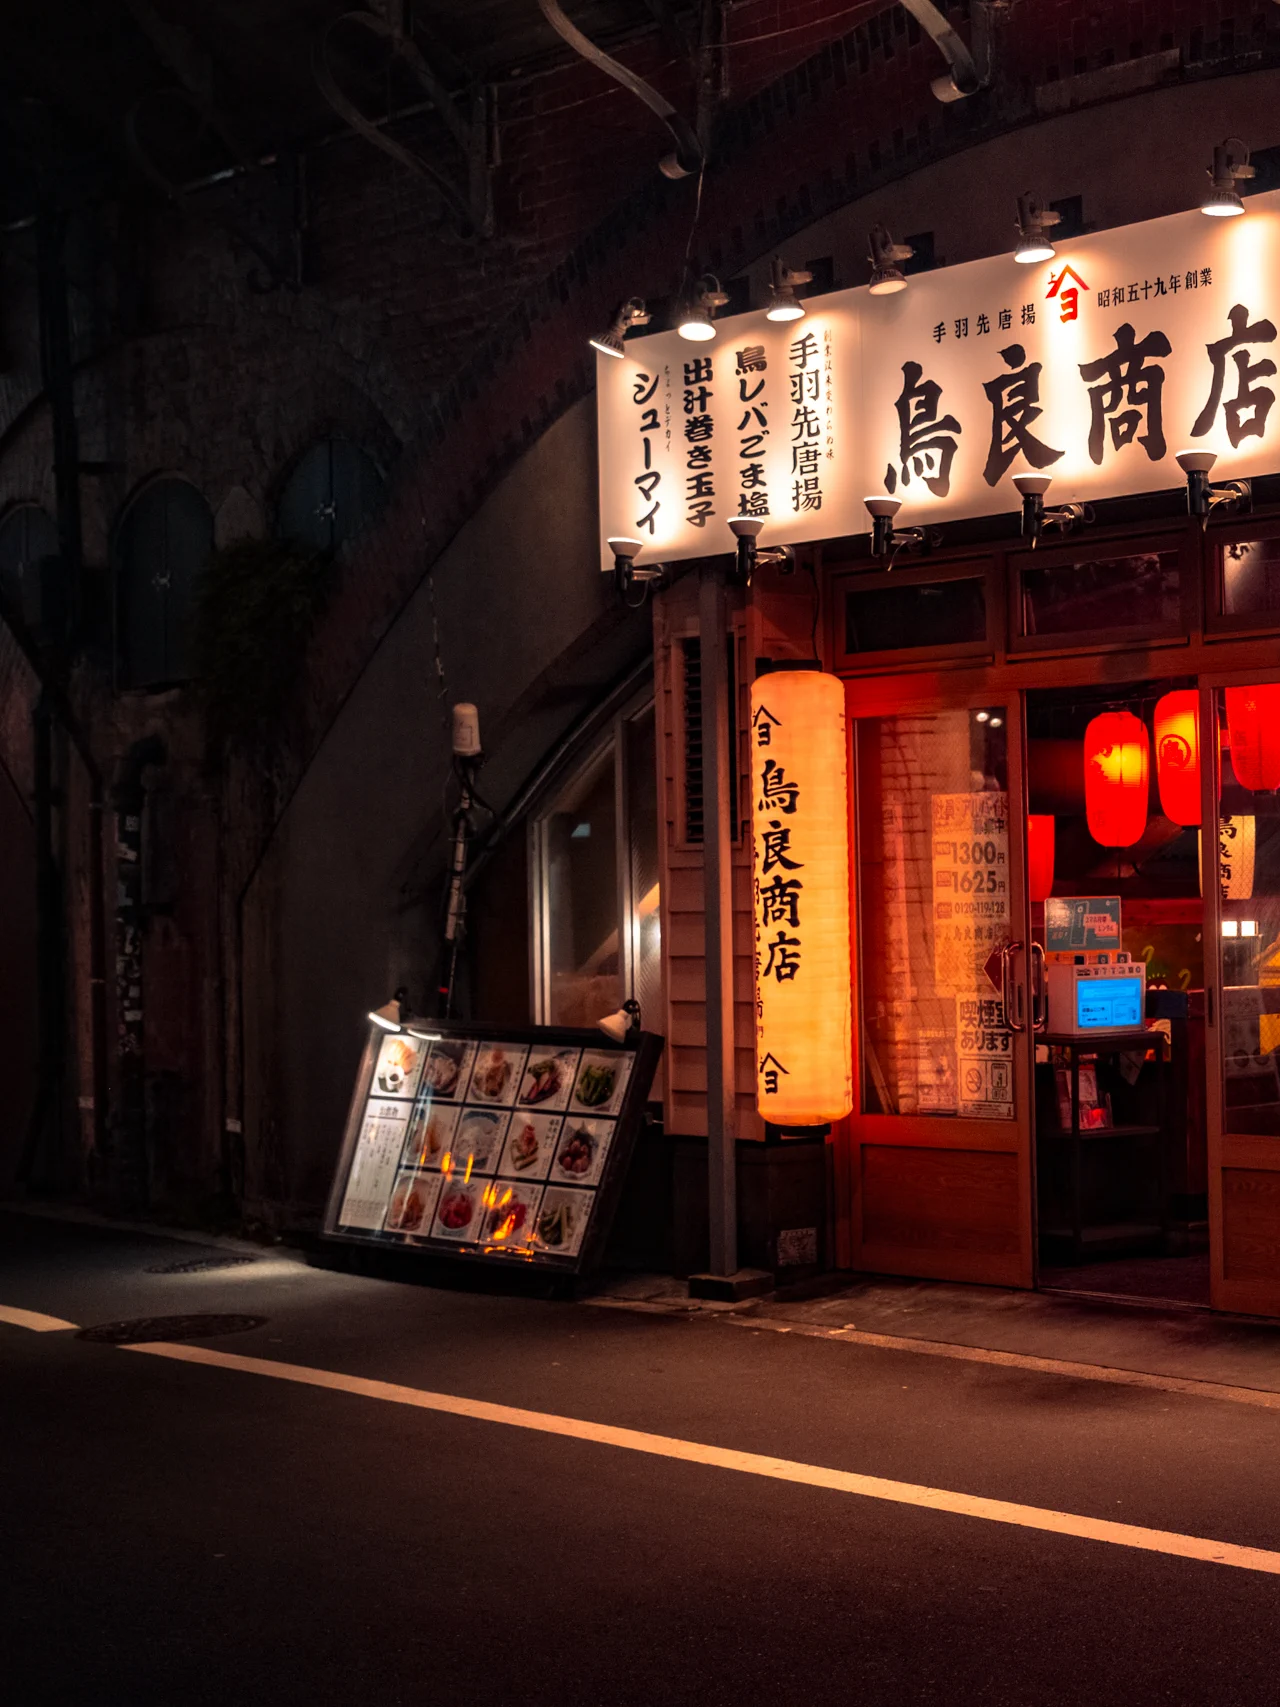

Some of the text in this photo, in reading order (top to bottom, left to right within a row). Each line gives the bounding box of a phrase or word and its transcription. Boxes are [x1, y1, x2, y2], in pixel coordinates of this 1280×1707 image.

[932, 303, 1036, 343] 手羽先唐揚
[1098, 267, 1213, 308] 昭和五十九年創業
[633, 373, 662, 535] シューマイ
[684, 357, 716, 528] 出汁巻き玉子
[735, 345, 770, 517] 鳥レバごま塩
[789, 332, 824, 512] 手羽先唐揚
[884, 303, 1278, 498] 鳥良商店
[758, 759, 804, 984] 鳥良商店
[961, 1030, 1012, 1052] あります
